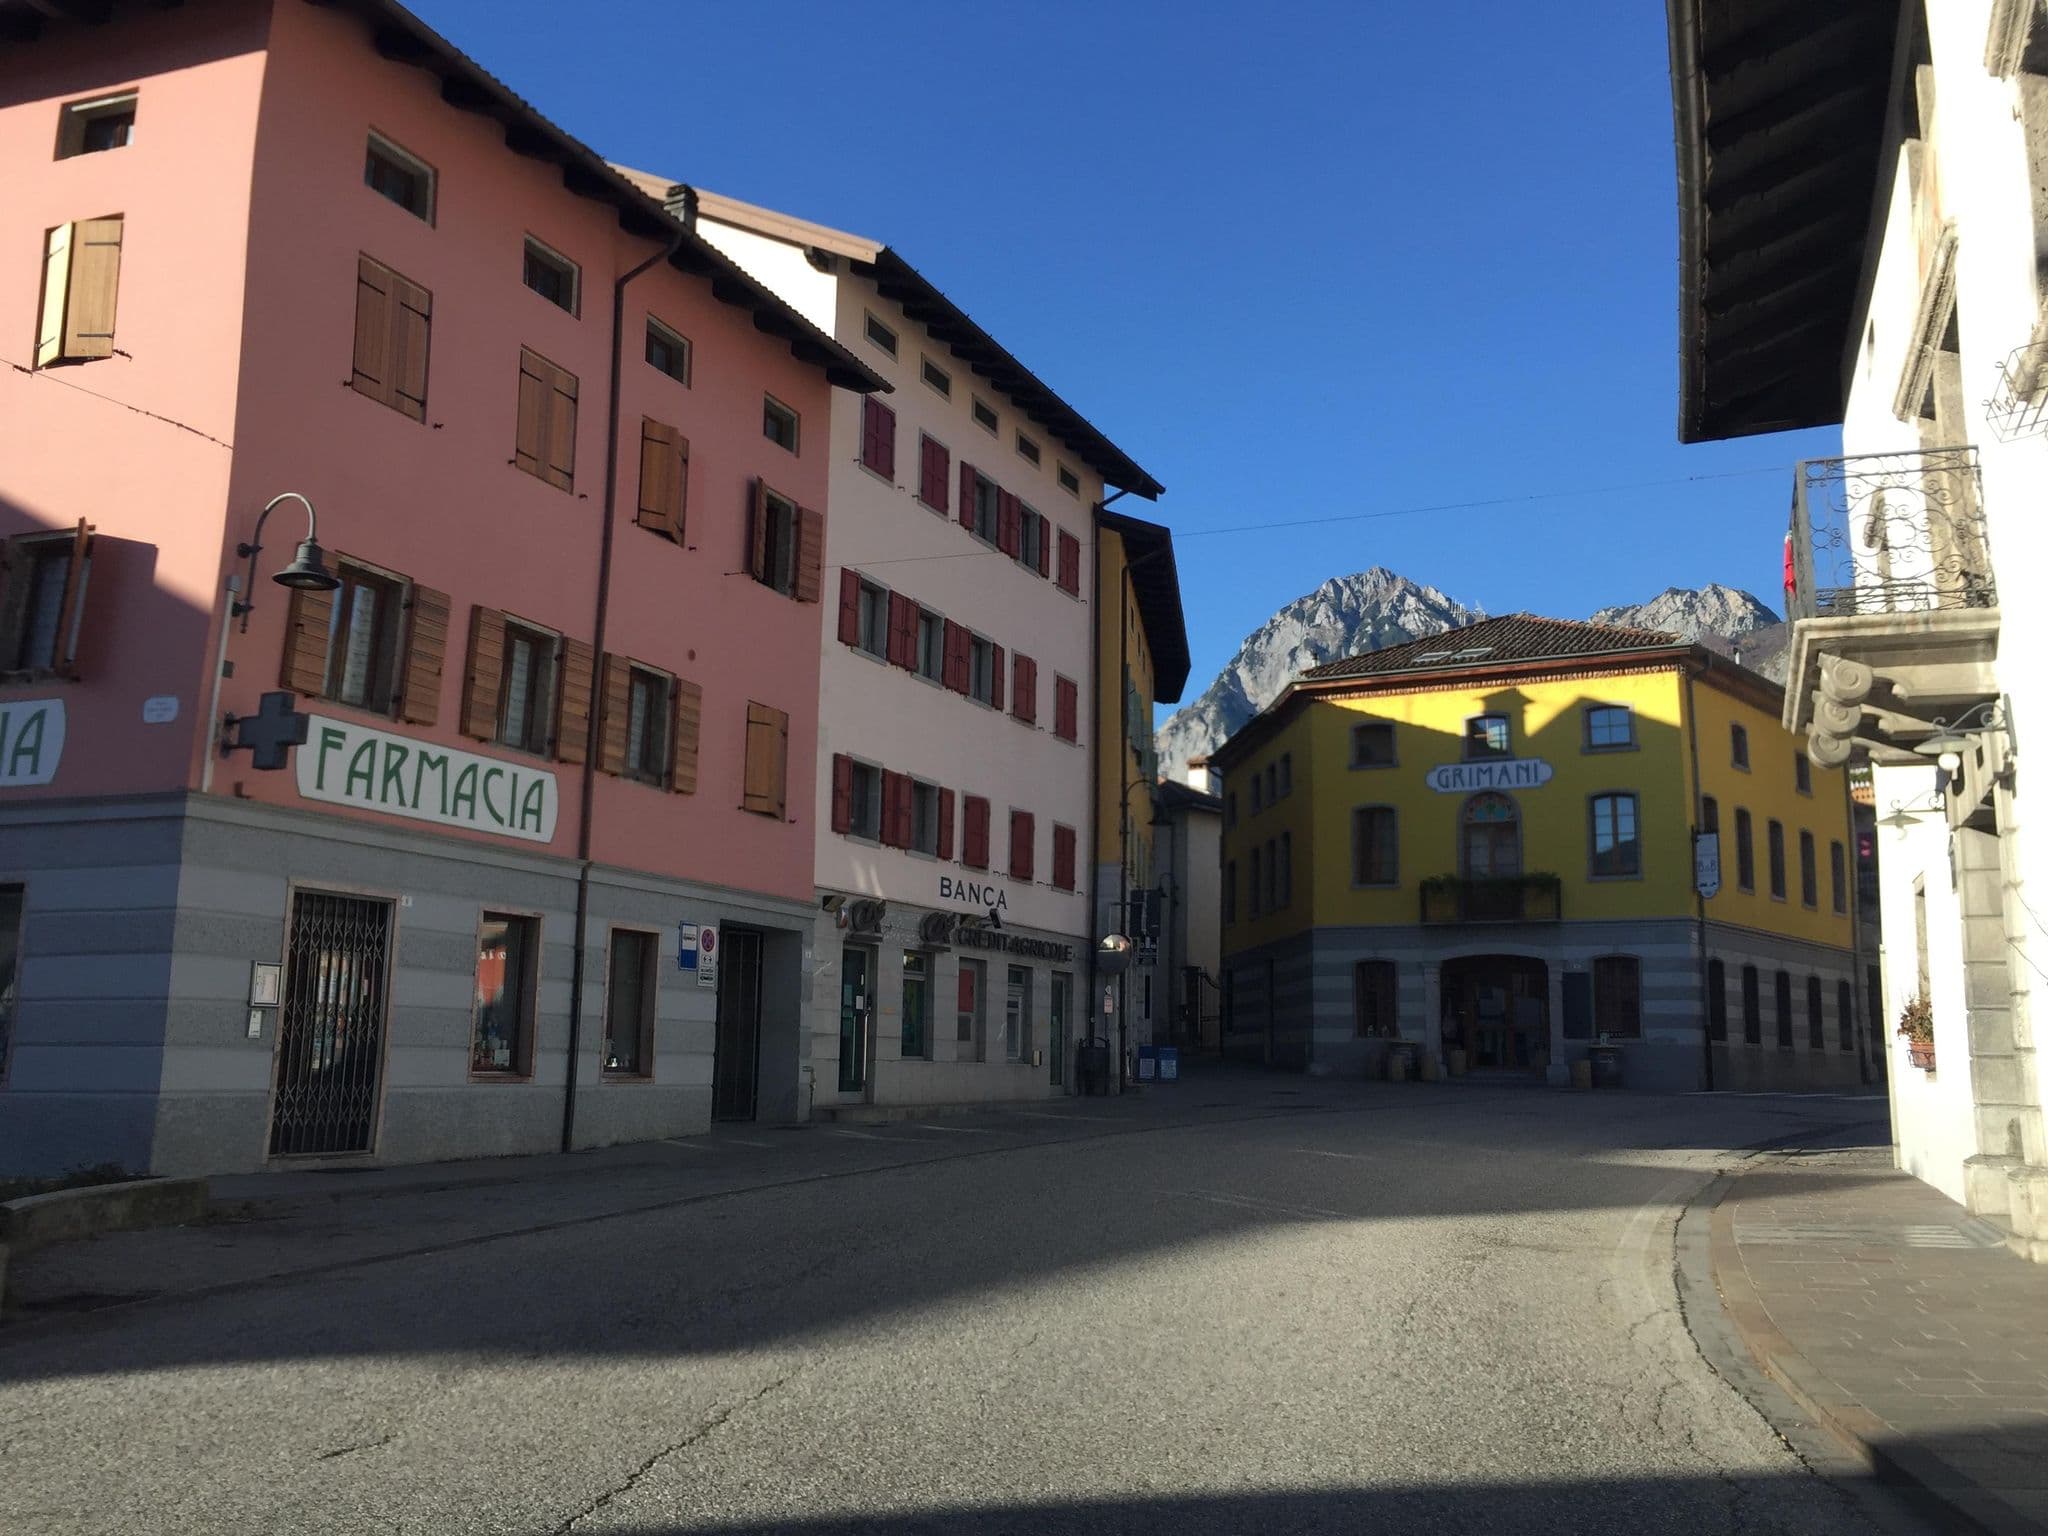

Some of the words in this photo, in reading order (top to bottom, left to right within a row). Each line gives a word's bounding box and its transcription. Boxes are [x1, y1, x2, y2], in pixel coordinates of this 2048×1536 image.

[315, 726, 546, 833] FARMACIA
[1438, 762, 1538, 789] GRIMANI
[940, 876, 1008, 910] BANCA
